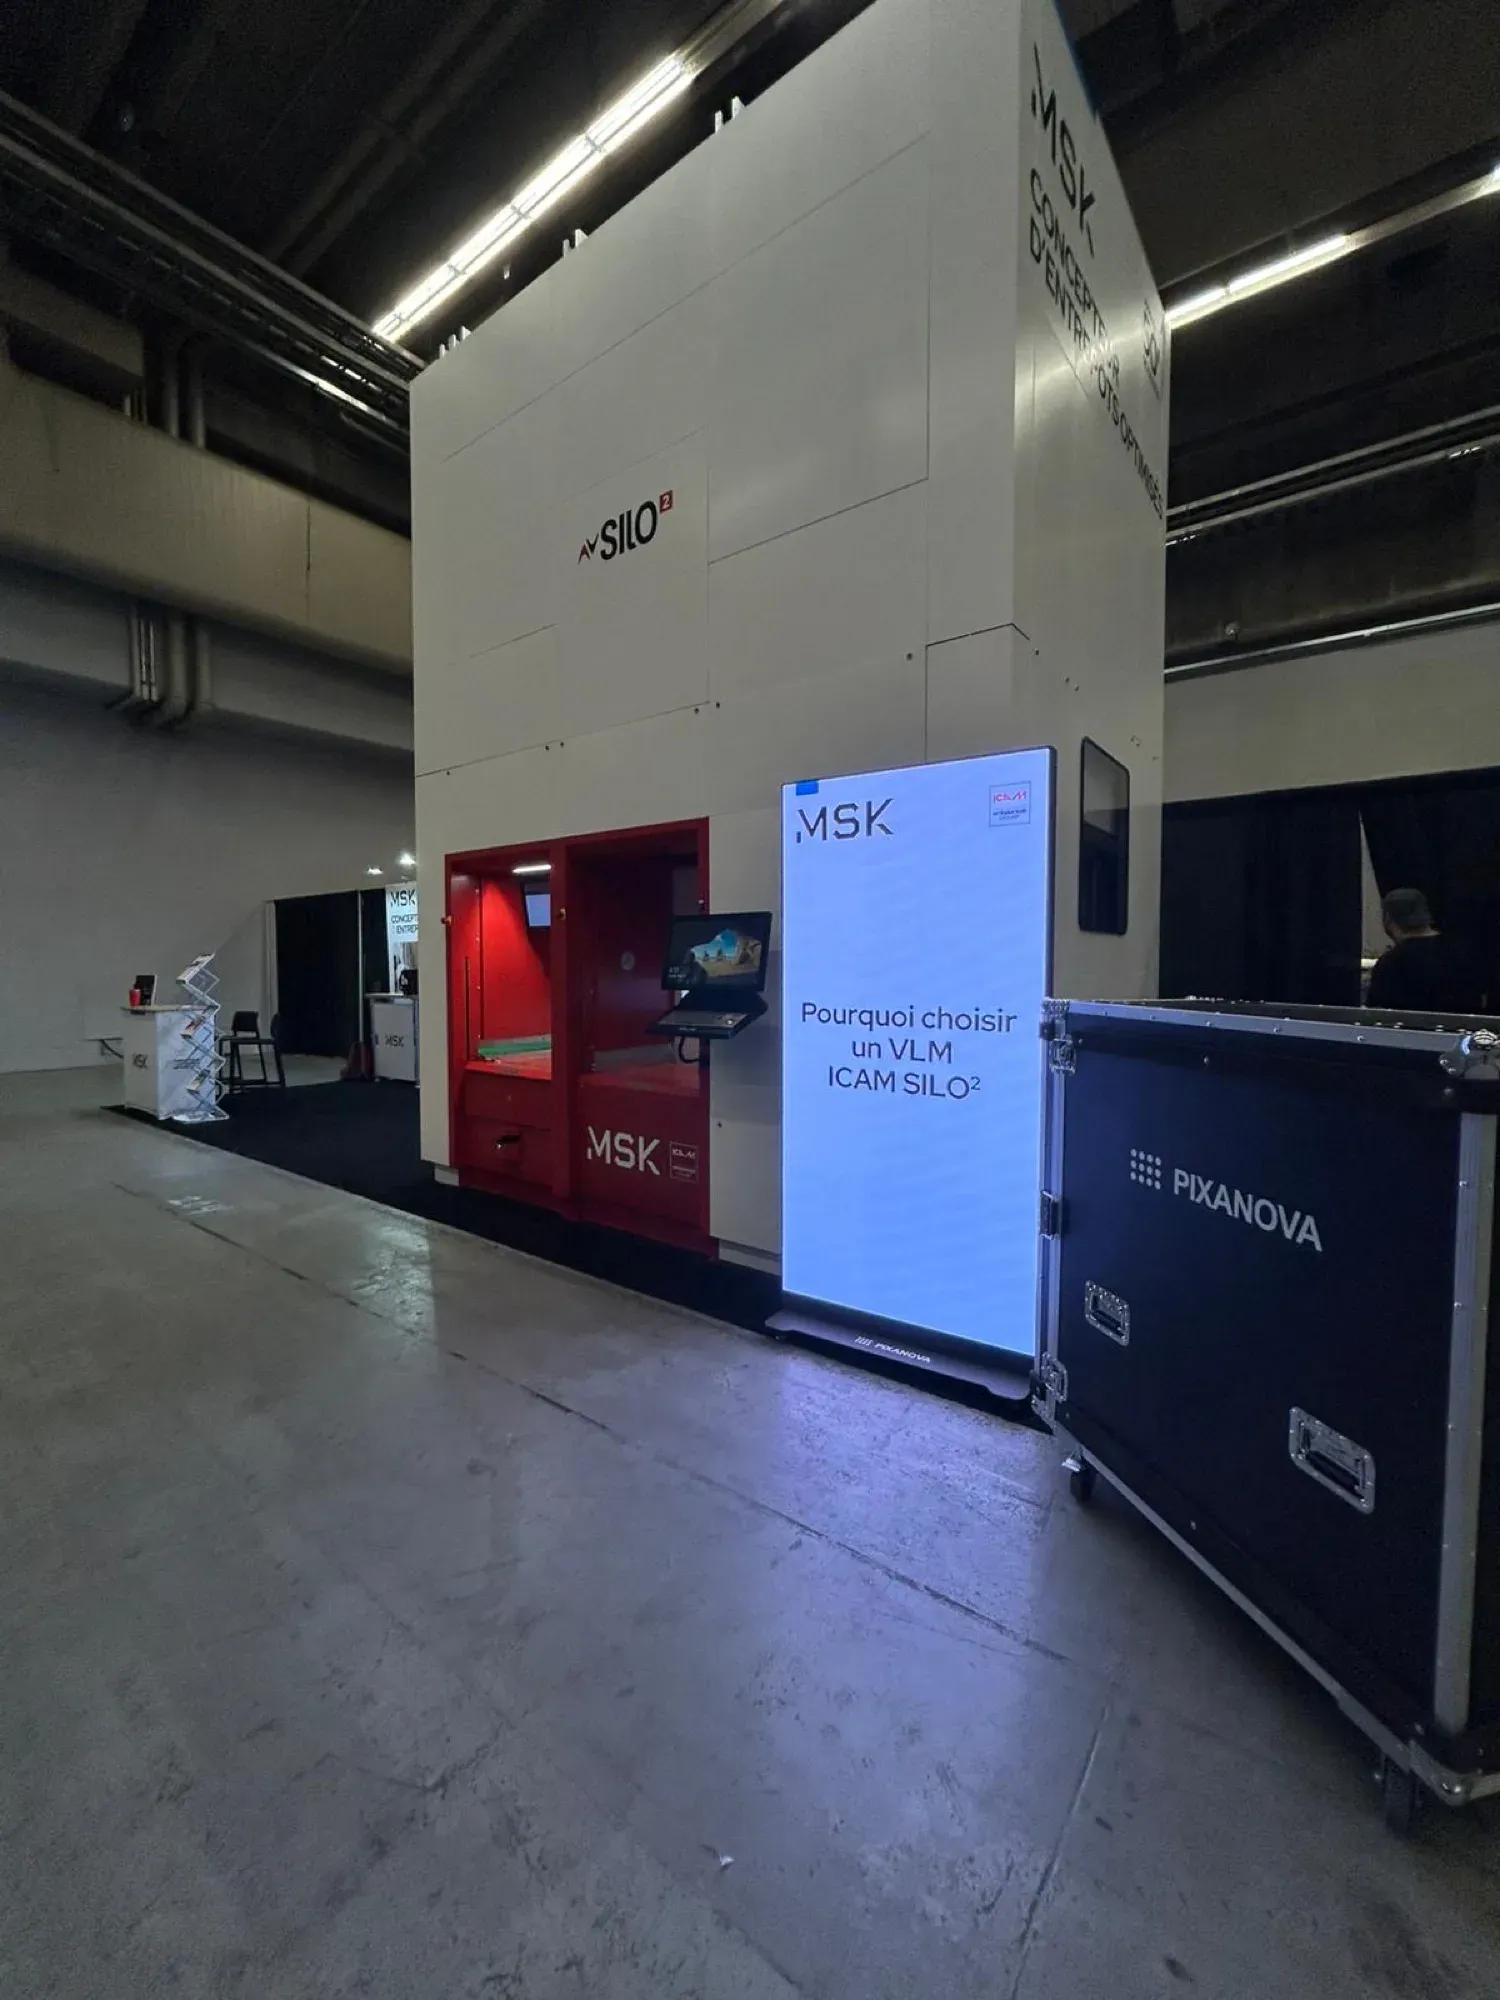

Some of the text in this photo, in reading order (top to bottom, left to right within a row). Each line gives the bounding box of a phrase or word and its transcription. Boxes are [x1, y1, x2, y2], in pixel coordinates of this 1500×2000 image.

[1031, 42, 1095, 259] MSK
[796, 799, 894, 844] MSK
[390, 889, 416, 908] MSK
[801, 1002, 1017, 1032] Pourquoi choisir
[852, 1038, 952, 1064] un VLM
[829, 1065, 895, 1093] ICAM
[587, 1125, 660, 1176] MSK
[1173, 1168, 1323, 1252] PIXANOVA
